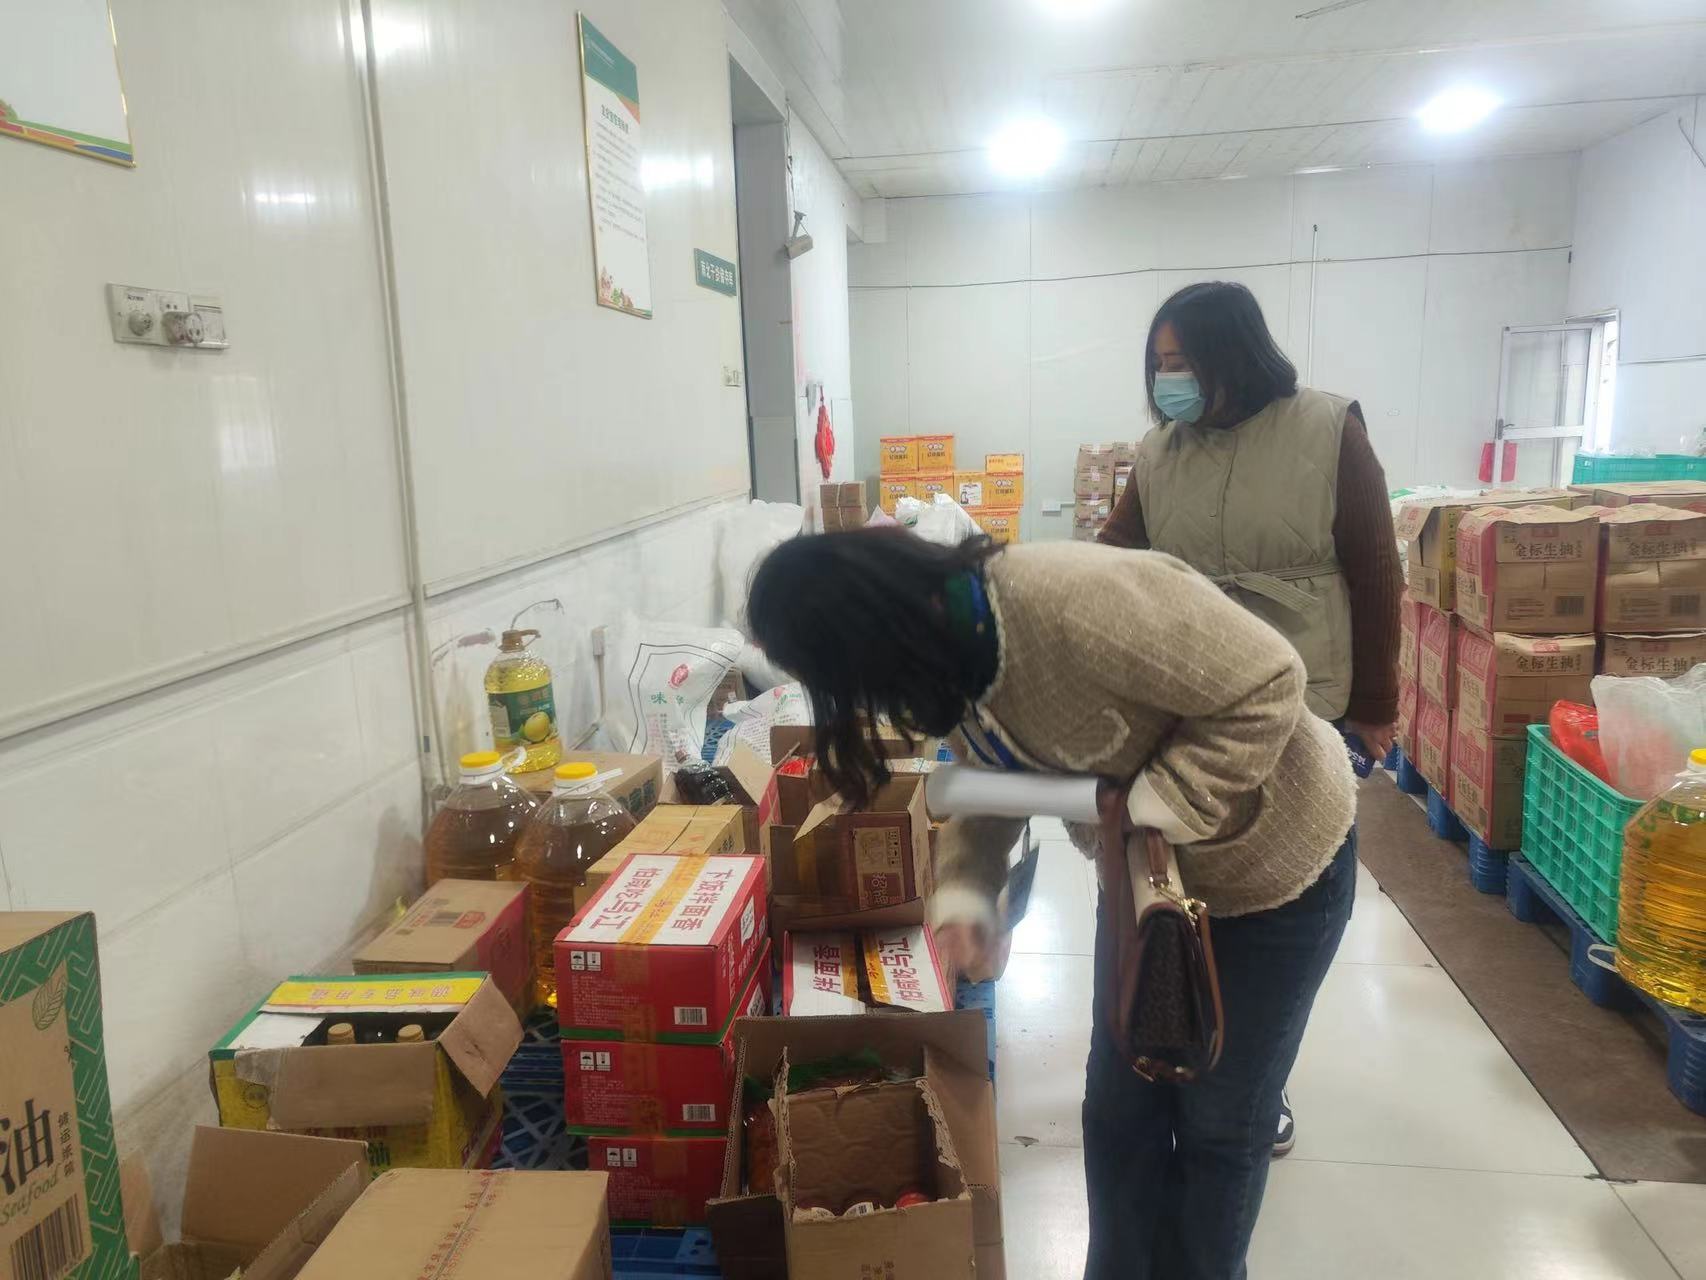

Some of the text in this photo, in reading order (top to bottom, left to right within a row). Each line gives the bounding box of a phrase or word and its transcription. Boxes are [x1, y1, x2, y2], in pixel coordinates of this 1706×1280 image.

[1516, 542, 1573, 557] 金标生抽
[1630, 540, 1687, 556] 金标生抽
[1516, 656, 1573, 671] 金标生抽
[1625, 657, 1687, 672] 金标生抽
[589, 866, 662, 930] 怕咸吃乌江
[672, 868, 735, 931] 下饭拌面香
[879, 937, 924, 1001] 怕咸吃乌江
